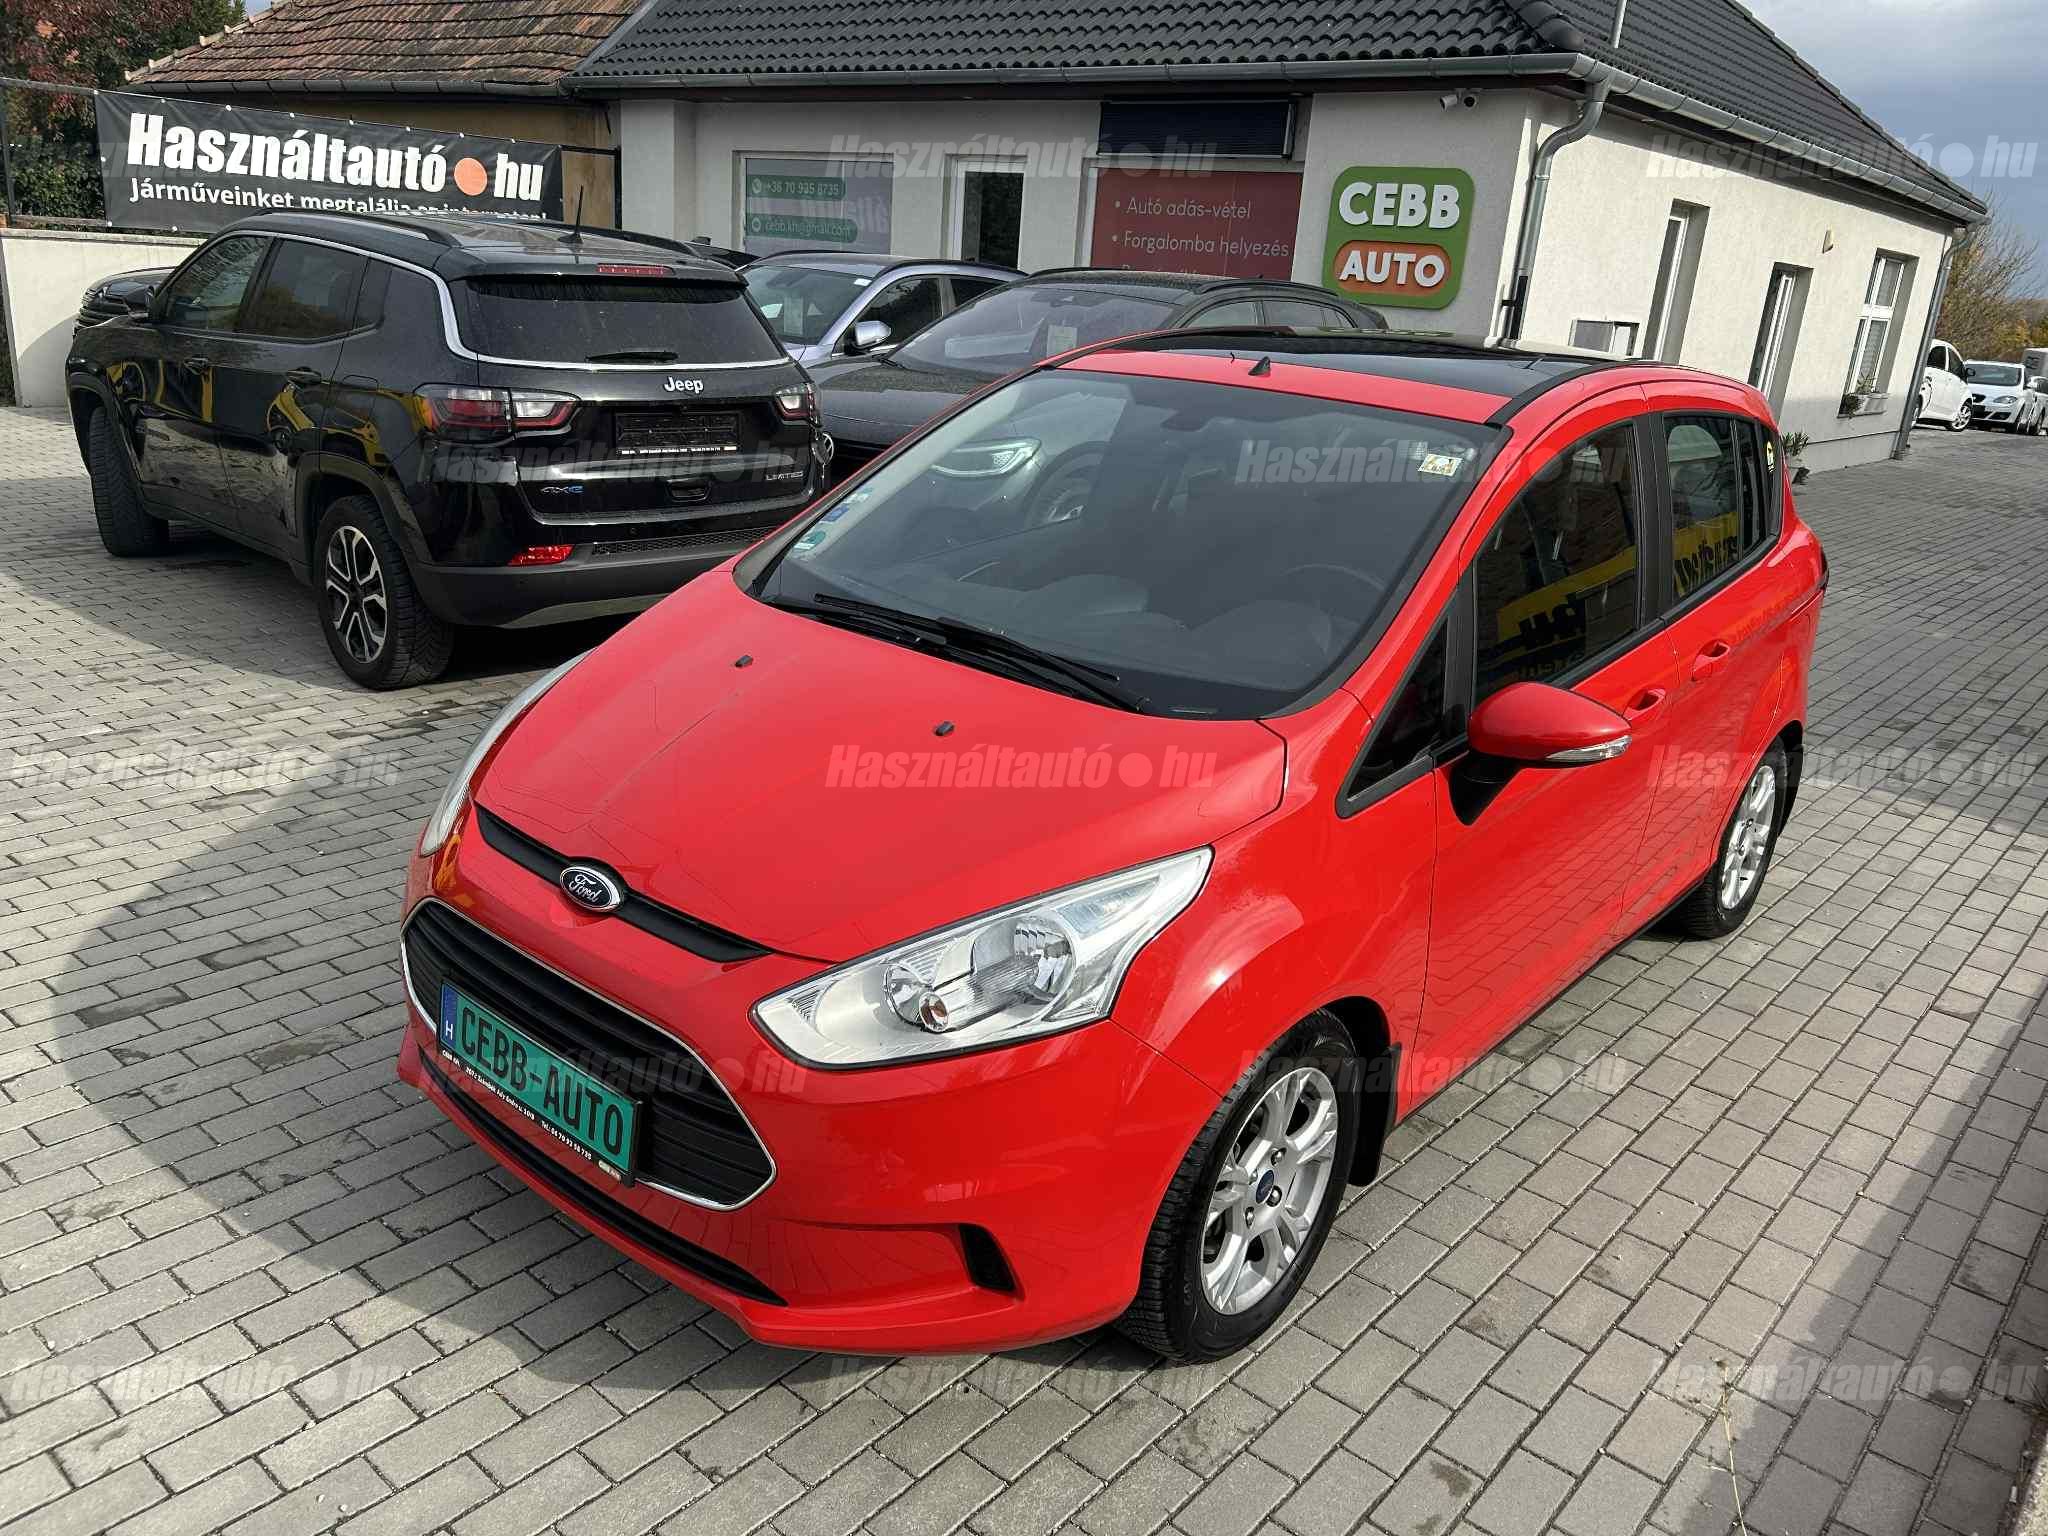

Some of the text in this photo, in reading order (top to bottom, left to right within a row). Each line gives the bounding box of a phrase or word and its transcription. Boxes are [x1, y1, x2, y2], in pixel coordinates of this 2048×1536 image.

[127, 112, 447, 192] Használtautó
[494, 153, 544, 200] hu
[130, 178, 295, 208] Járműveinket
[785, 182, 796, 193] 70
[1127, 197, 1252, 219] Autó adás-vétel
[1339, 182, 1460, 229] CEBB
[1124, 230, 1290, 259] Forgalomba helyezés
[1339, 250, 1445, 287] AUTO
[664, 376, 704, 394] Jeep
[569, 873, 602, 902] Ford
[445, 1021, 454, 1040] H
[462, 1007, 624, 1157] CEBB-AUTO
